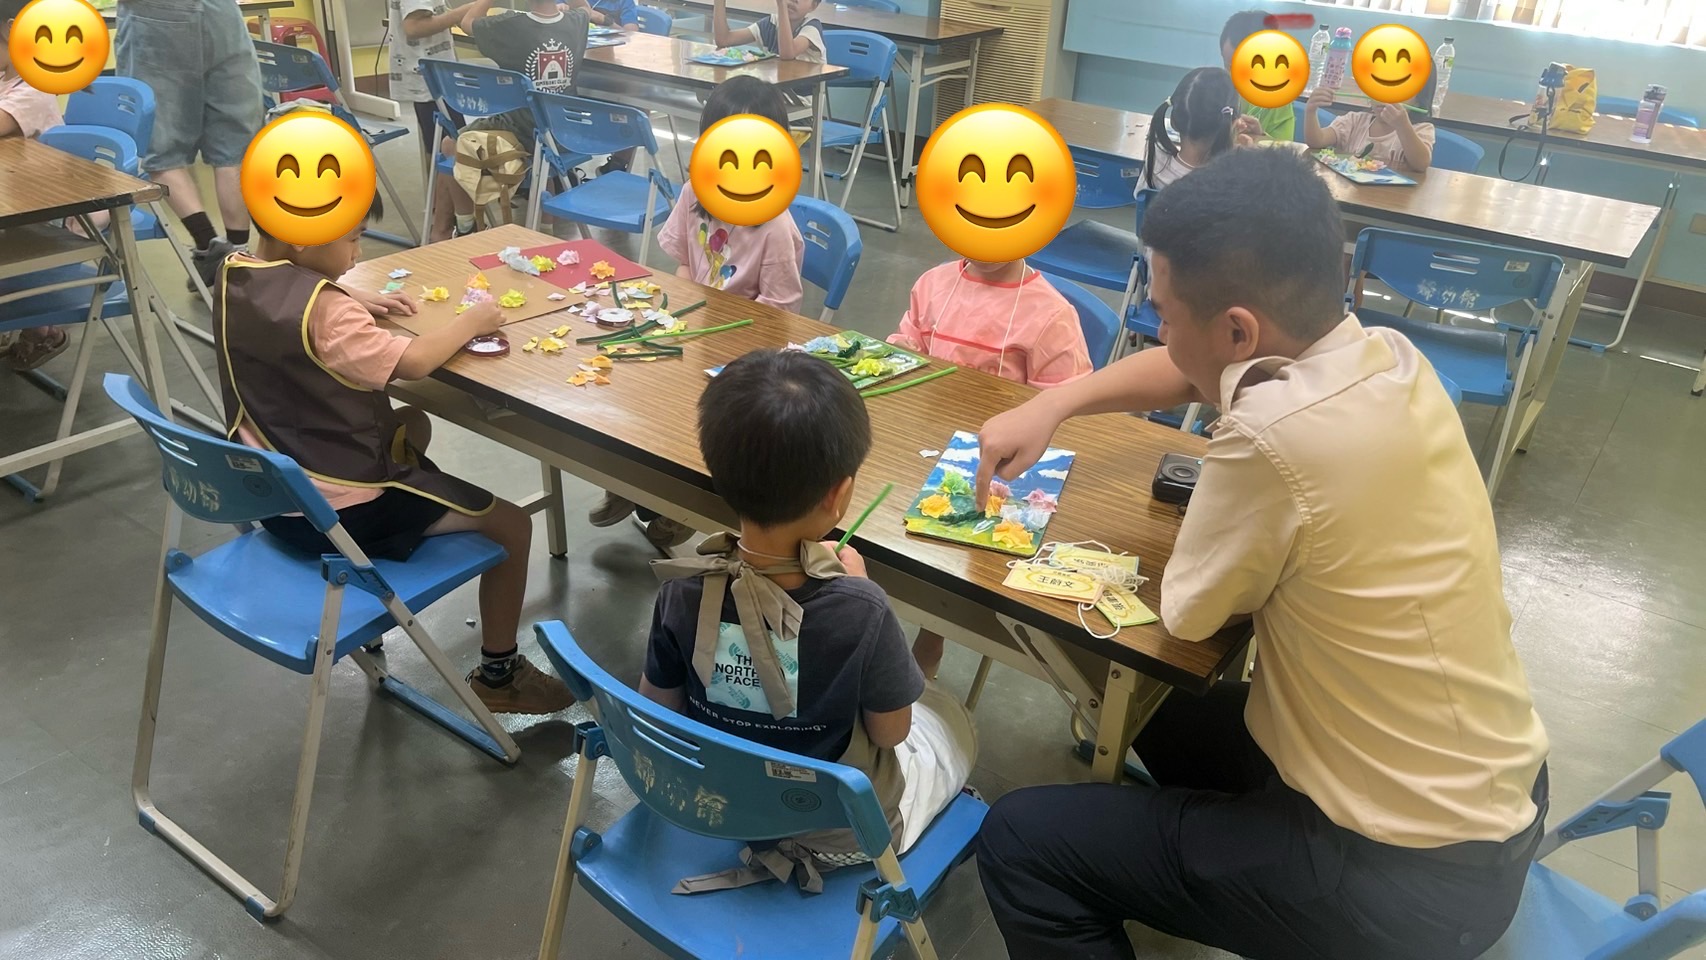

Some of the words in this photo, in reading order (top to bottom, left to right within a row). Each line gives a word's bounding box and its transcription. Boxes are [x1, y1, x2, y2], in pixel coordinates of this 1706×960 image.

[735, 654, 752, 666] TH
[725, 675, 761, 688] FACE
[689, 695, 719, 719] NEVER
[722, 716, 752, 728] STOP
[755, 723, 822, 732] EXPLORING
